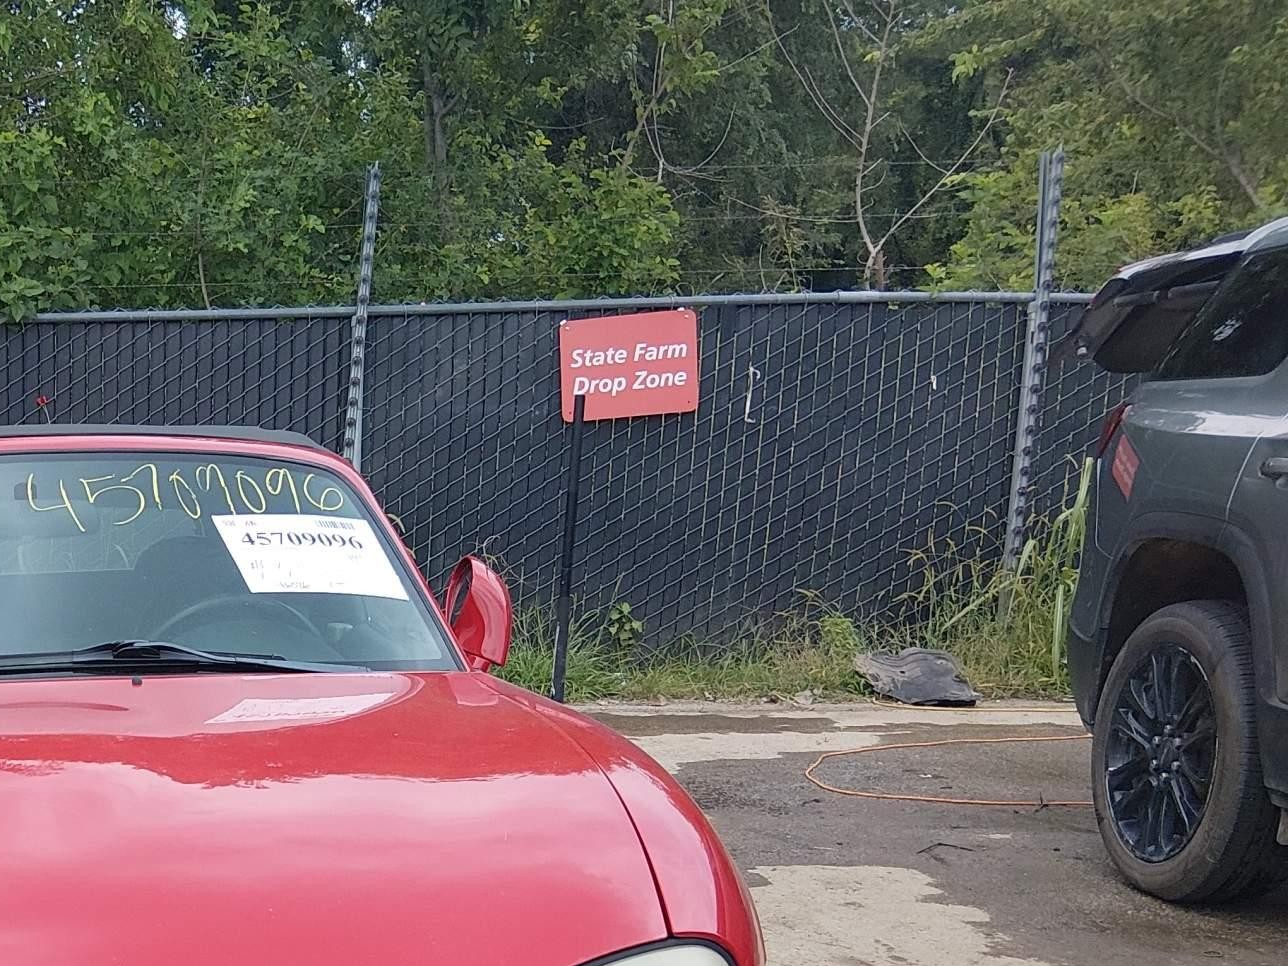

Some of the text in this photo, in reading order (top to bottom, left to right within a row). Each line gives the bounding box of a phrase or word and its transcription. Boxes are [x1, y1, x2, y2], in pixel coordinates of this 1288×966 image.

[570, 342, 688, 368] State Farm
[573, 370, 688, 397] Drop Zone
[26, 464, 344, 532] 45709096
[241, 530, 364, 550] 45709096
